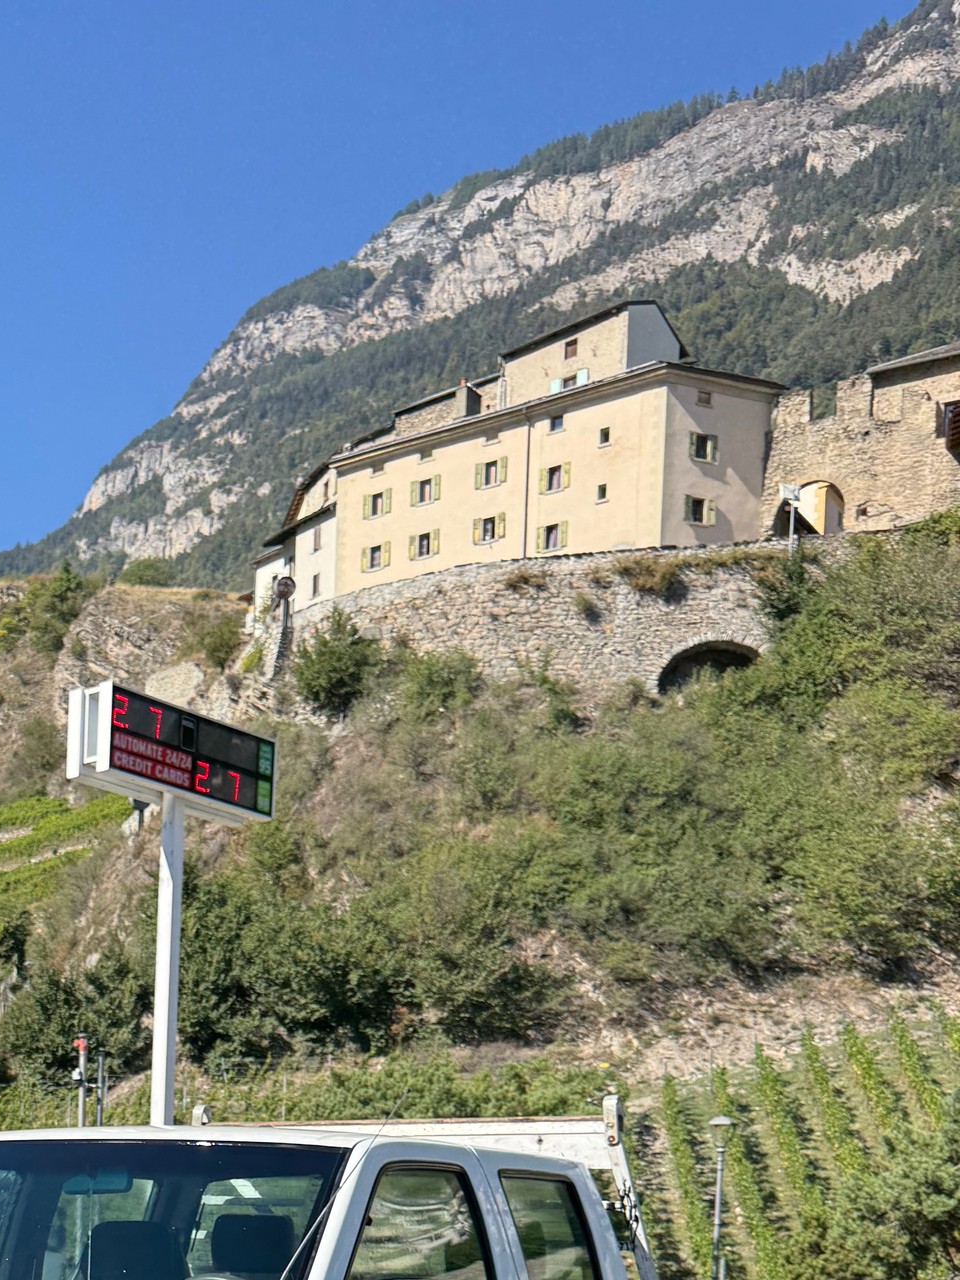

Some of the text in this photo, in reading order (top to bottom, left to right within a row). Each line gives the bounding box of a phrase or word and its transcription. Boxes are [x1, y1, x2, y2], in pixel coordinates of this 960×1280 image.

[113, 733, 192, 771] AUTOMATE 24/24
[113, 752, 190, 787] CREDIT CARDS
